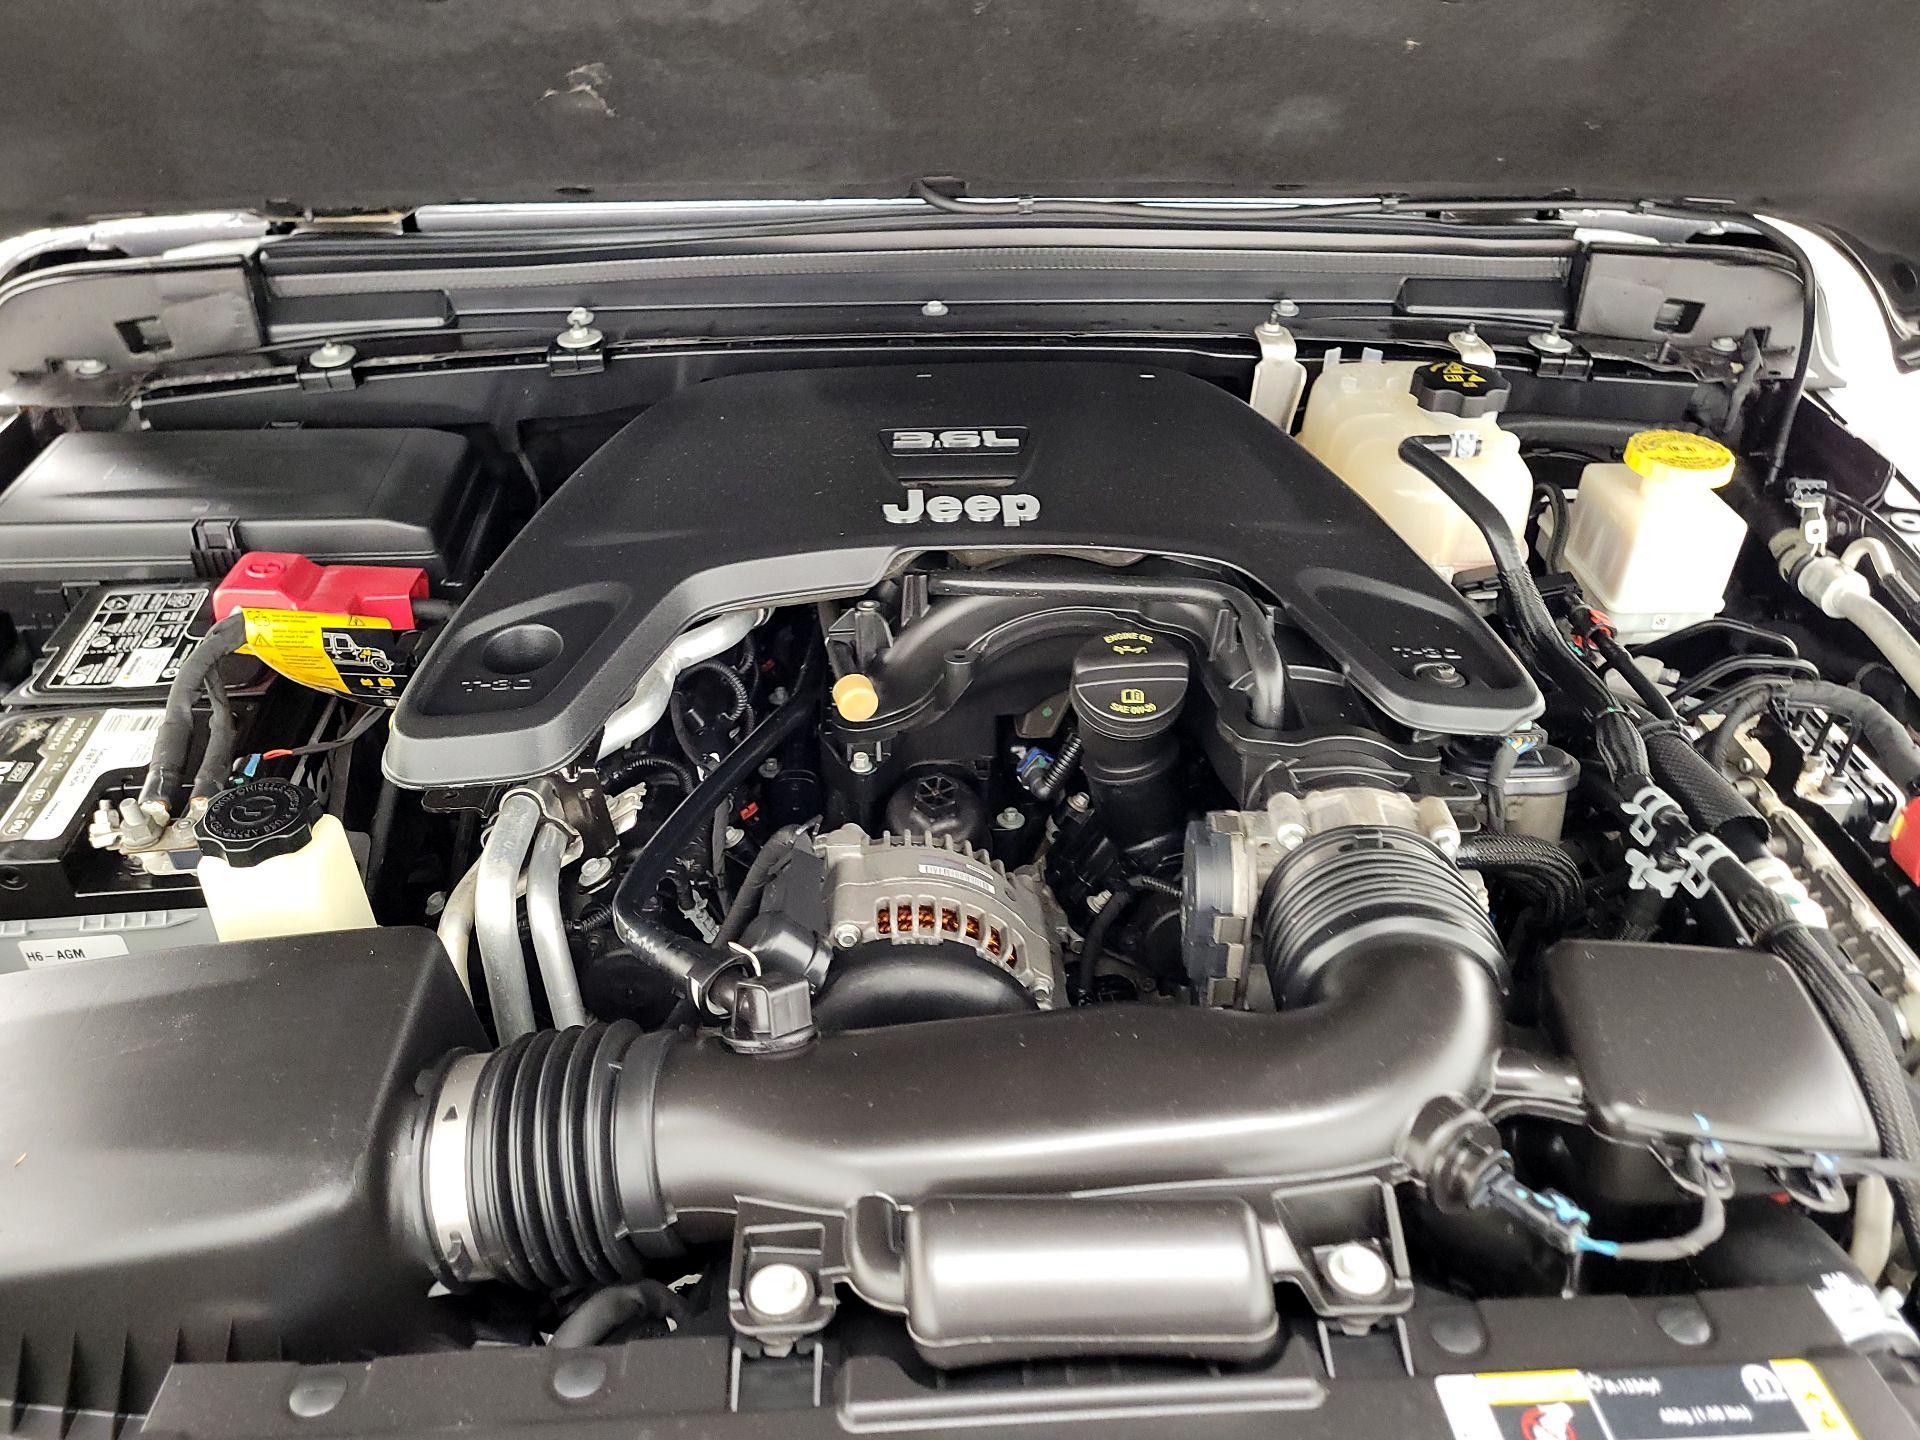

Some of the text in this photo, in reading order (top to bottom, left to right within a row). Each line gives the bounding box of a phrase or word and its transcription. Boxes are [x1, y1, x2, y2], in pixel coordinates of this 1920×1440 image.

[892, 430, 1020, 449] 3.6L
[882, 489, 1041, 527] Jeep
[1103, 632, 1154, 644] ENGINE OIL
[1109, 702, 1157, 715] SAE 0W-20
[48, 717, 76, 751] PLATINUM
